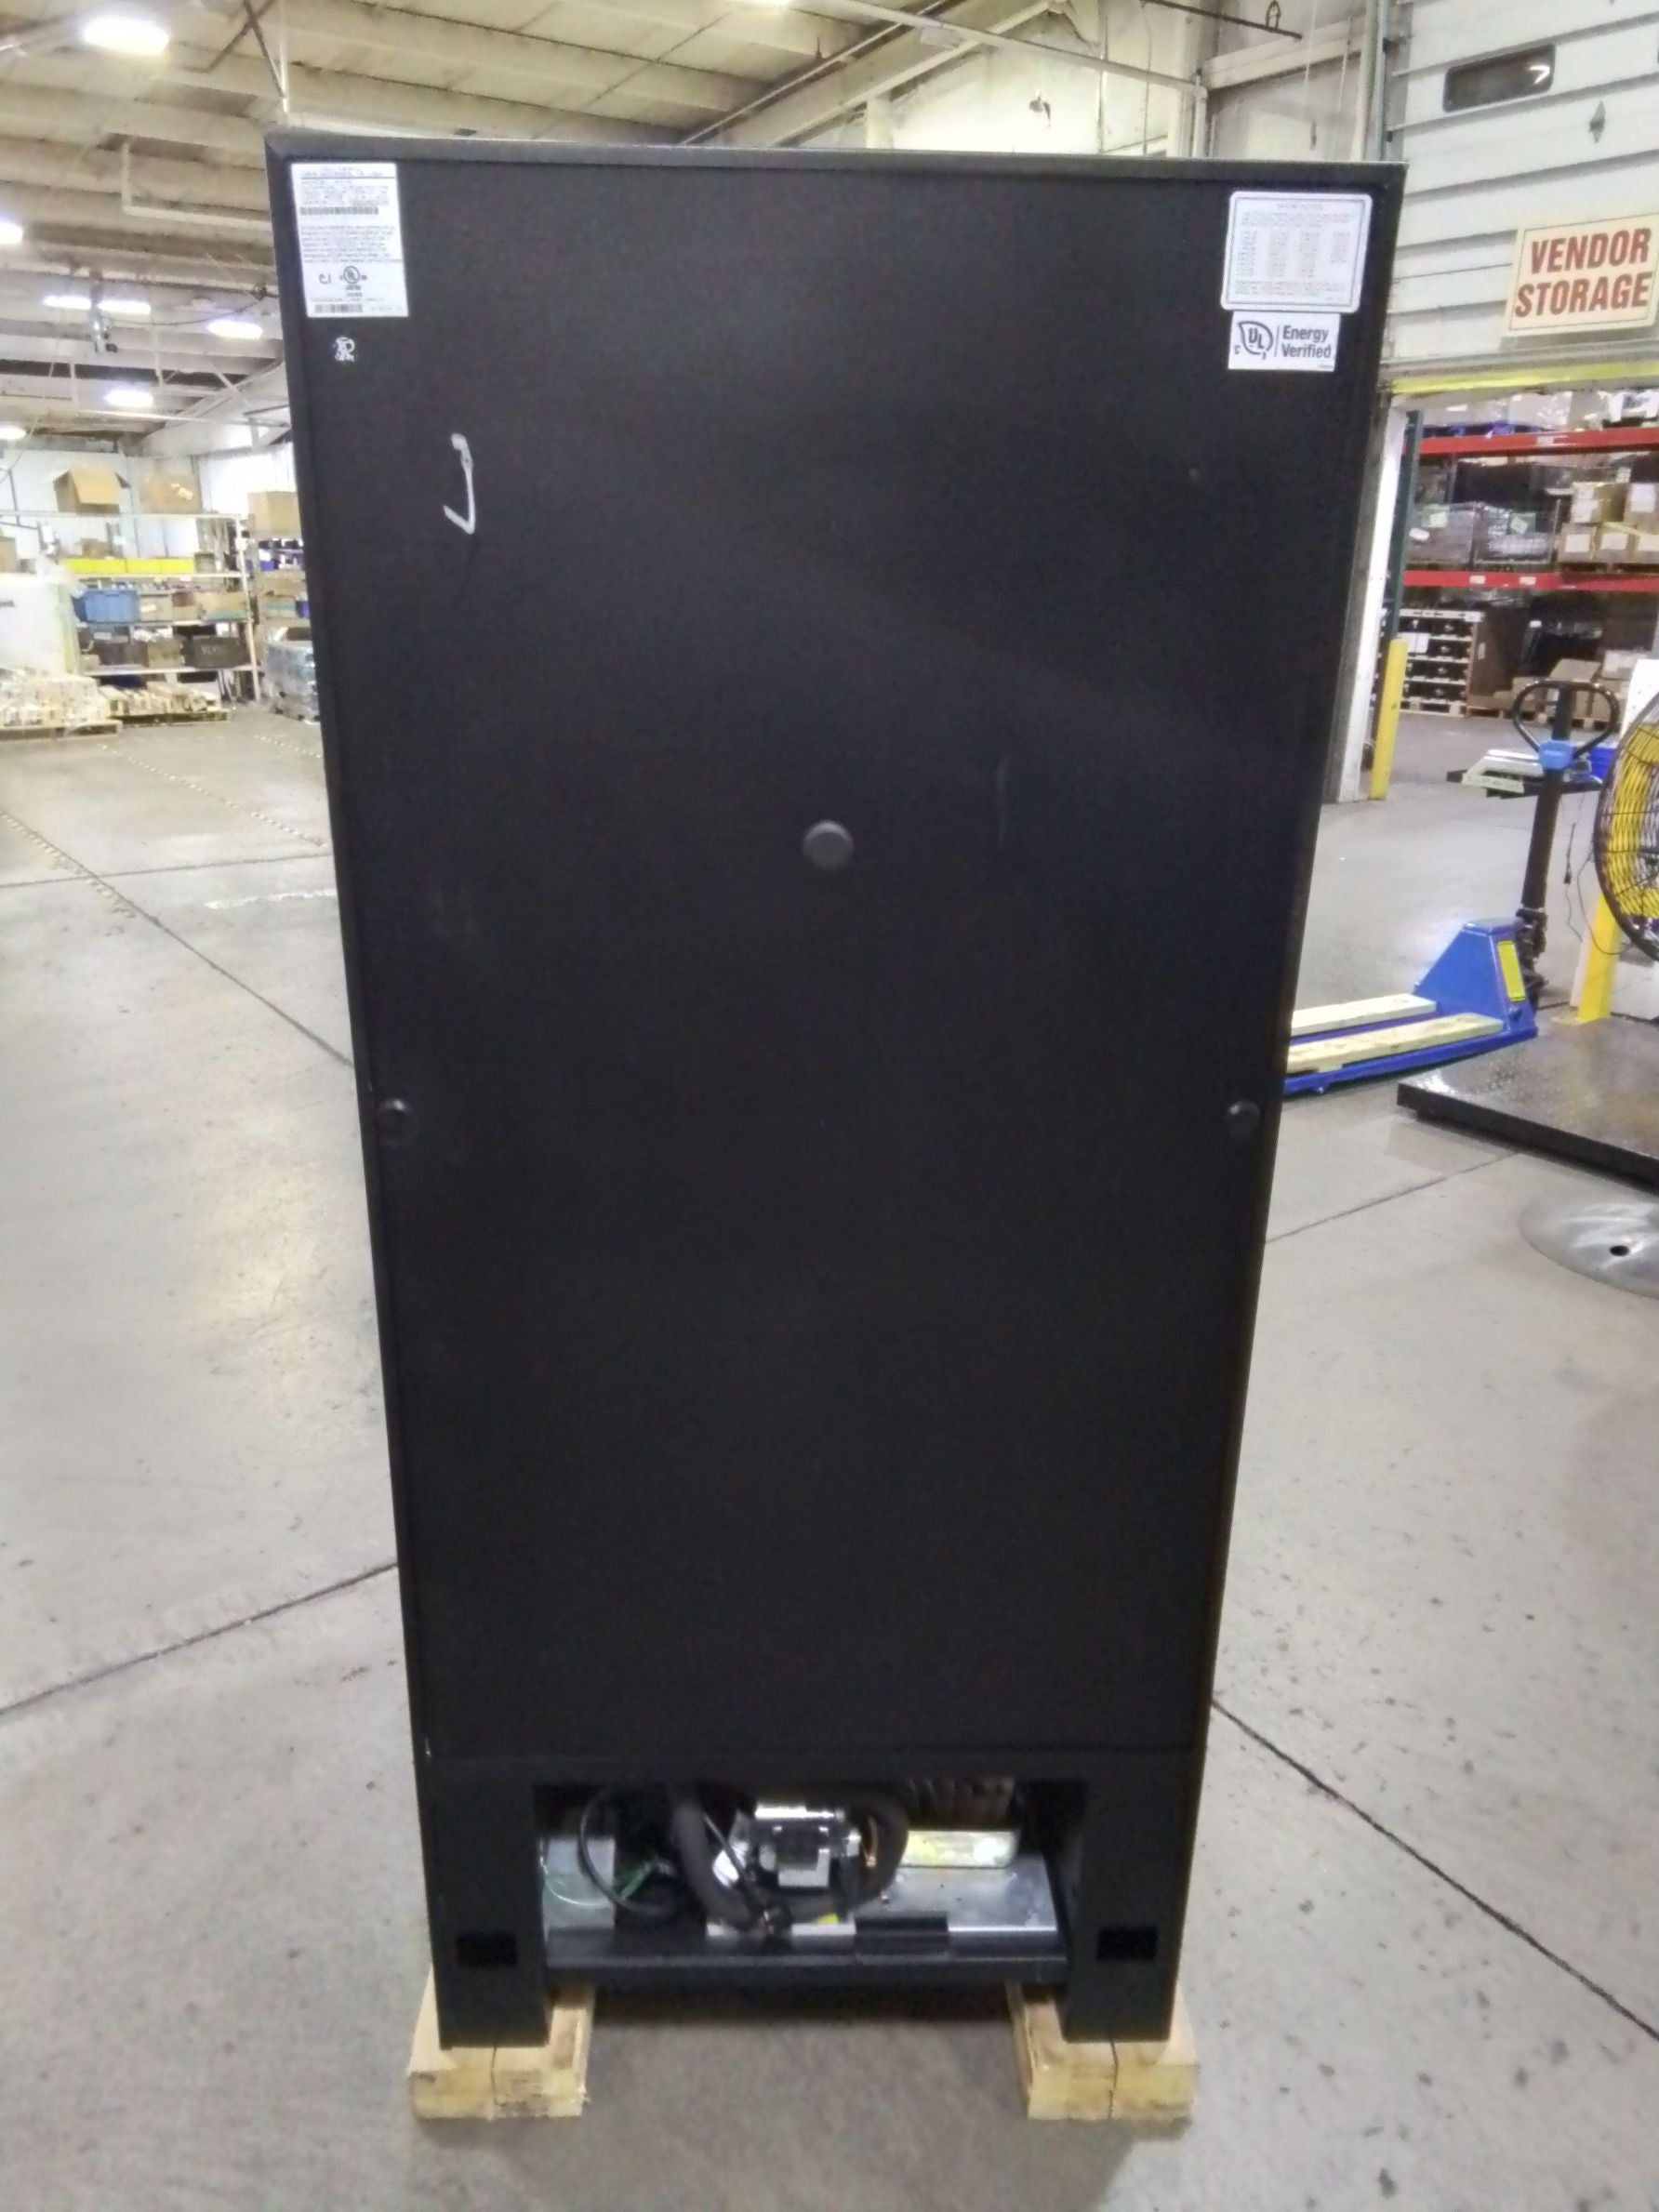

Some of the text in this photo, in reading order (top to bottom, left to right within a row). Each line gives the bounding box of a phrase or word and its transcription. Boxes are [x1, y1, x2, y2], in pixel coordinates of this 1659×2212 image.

[1532, 228, 1652, 274] VENDOR
[1515, 272, 1652, 317] STORAGE
[1248, 327, 1265, 349] UL
[1282, 325, 1329, 343] Energy
[1281, 343, 1332, 359] Verified
